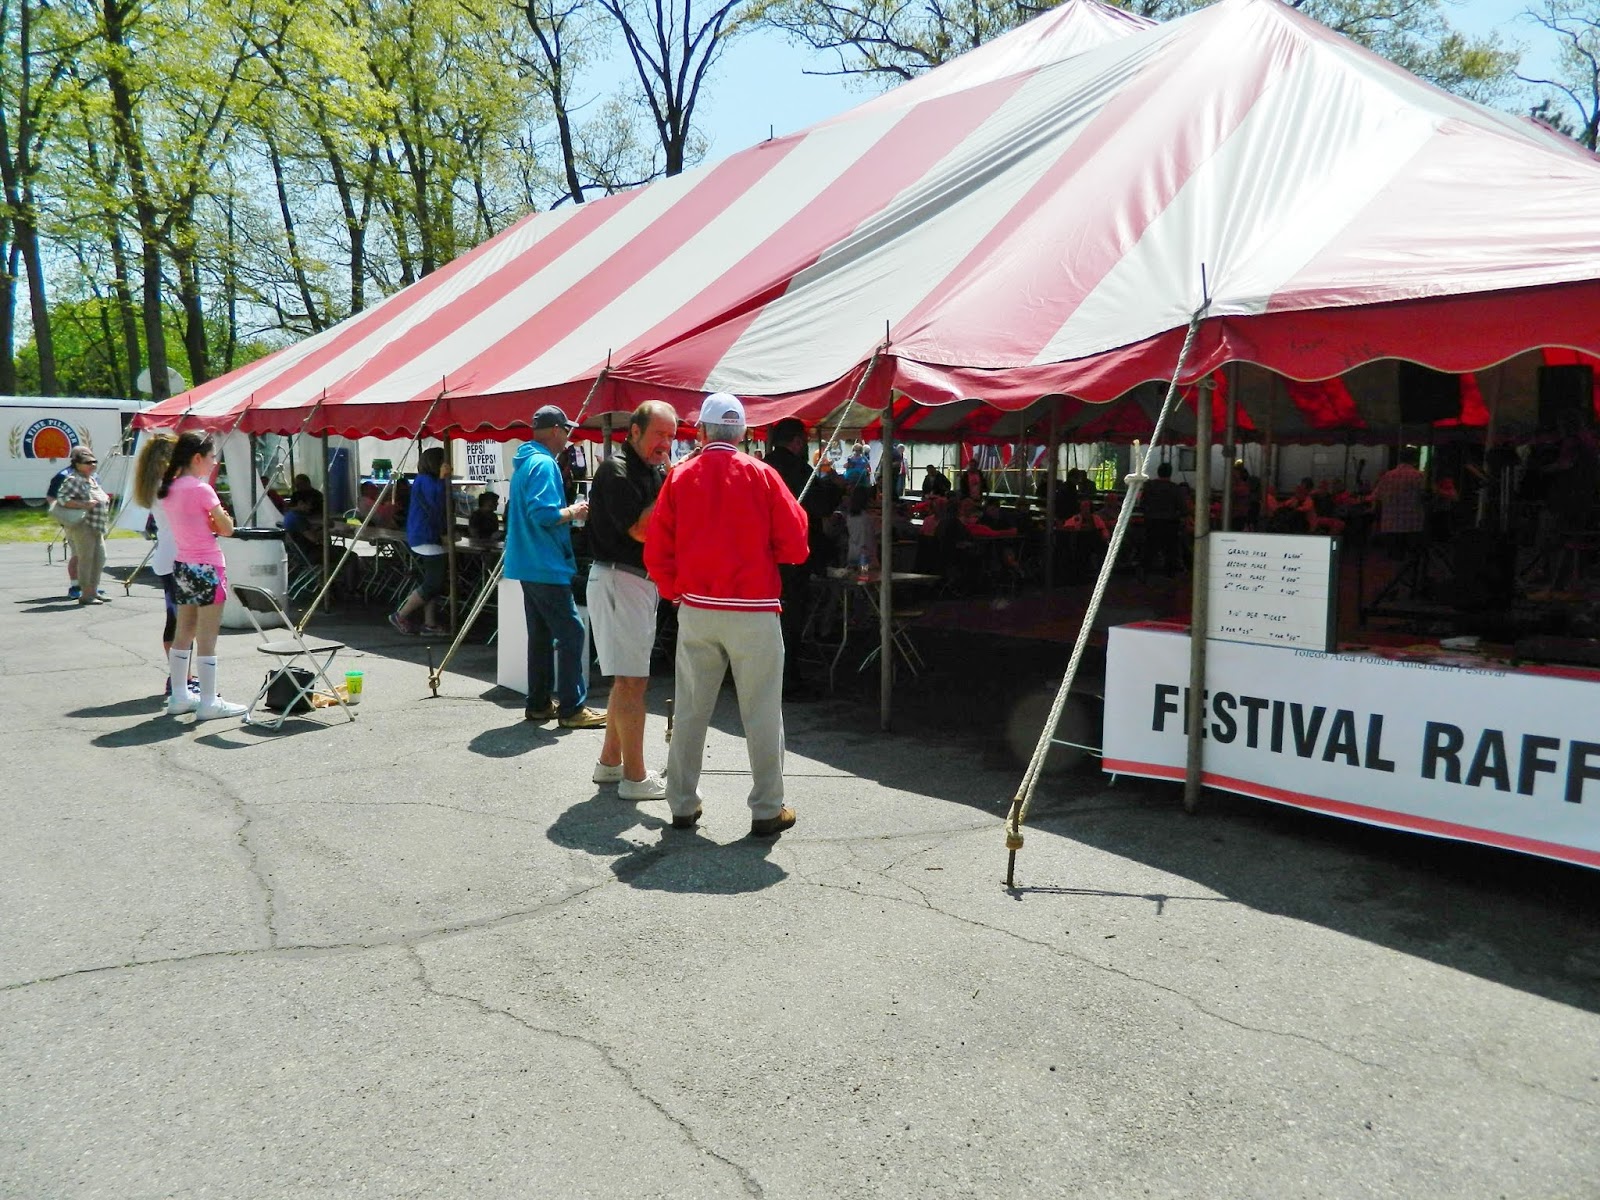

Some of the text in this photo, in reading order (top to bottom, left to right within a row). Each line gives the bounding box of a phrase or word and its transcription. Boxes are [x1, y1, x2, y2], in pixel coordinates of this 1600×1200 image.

[28, 421, 46, 436] FINE
[49, 420, 78, 444] PILSNER
[466, 445, 485, 454] PEPSI
[468, 455, 476, 464] DT
[469, 465, 495, 475] MT DEW
[1228, 548, 1249, 556] GRAND
[1246, 611, 1258, 619] PER
[1263, 613, 1287, 622] TICKET
[1294, 649, 1328, 660] Toledo
[1331, 653, 1356, 663] Area
